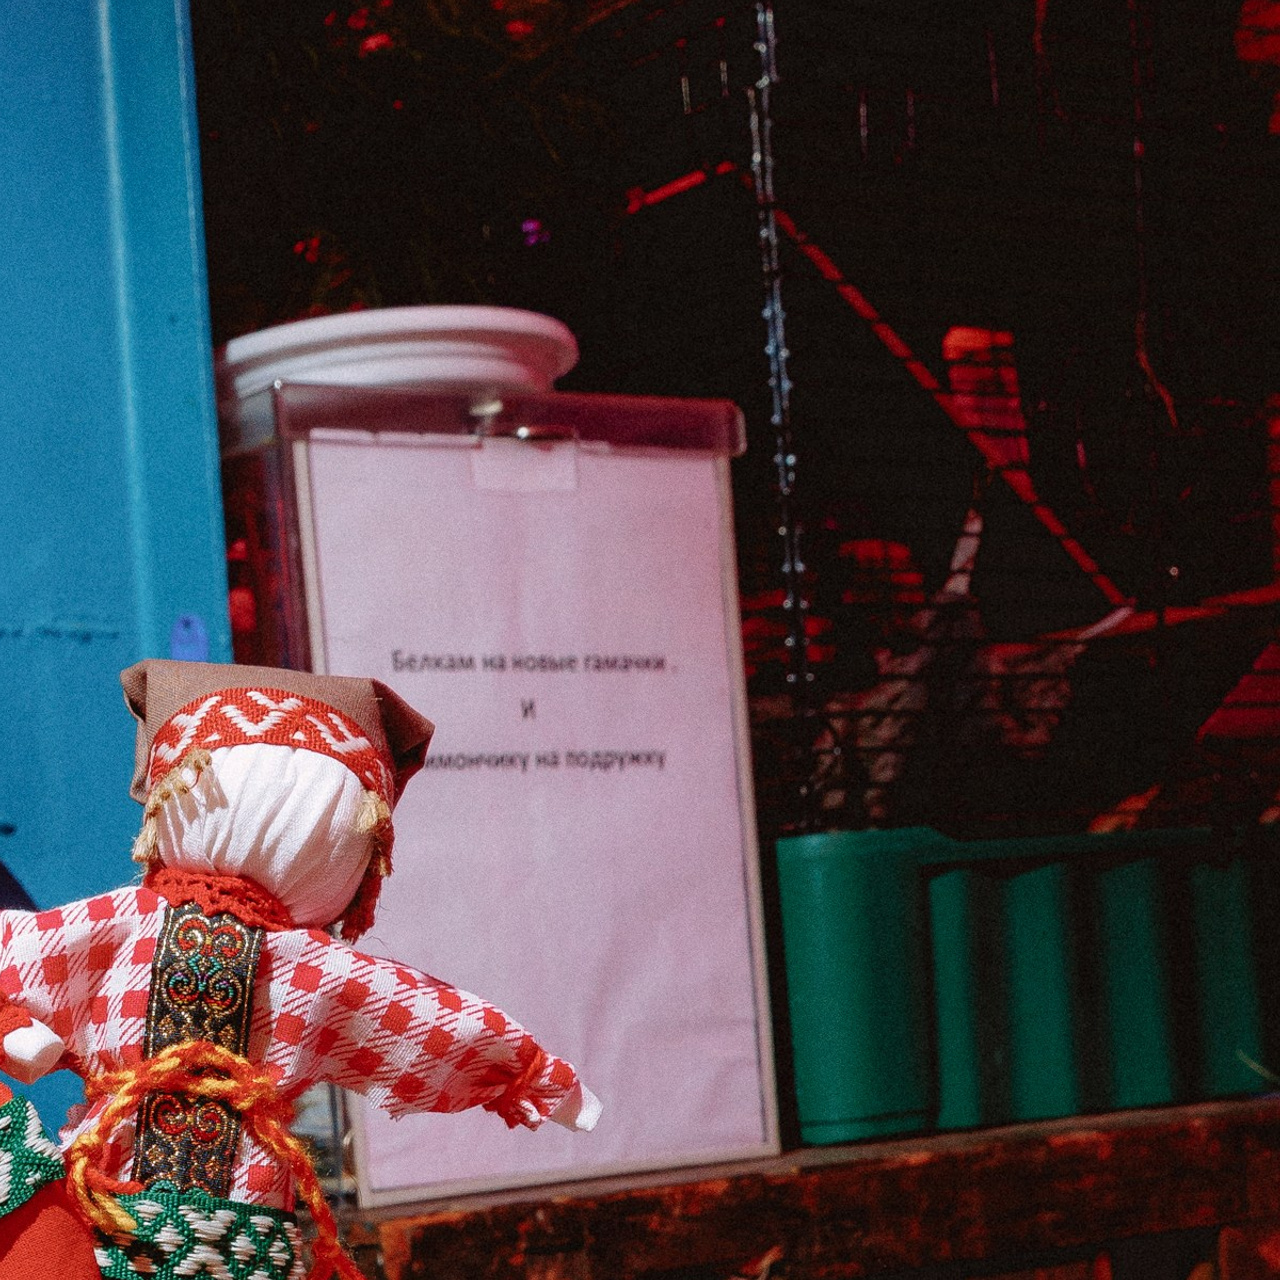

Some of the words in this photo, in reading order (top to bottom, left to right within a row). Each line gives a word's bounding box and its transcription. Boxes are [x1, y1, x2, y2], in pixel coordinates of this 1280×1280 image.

[391, 649, 475, 673] Белкам
[482, 655, 507, 673] на
[511, 655, 577, 673] новые
[584, 654, 666, 672] гамачки
[424, 753, 530, 774] имончику
[535, 753, 560, 770] на
[566, 752, 666, 772] подружку
